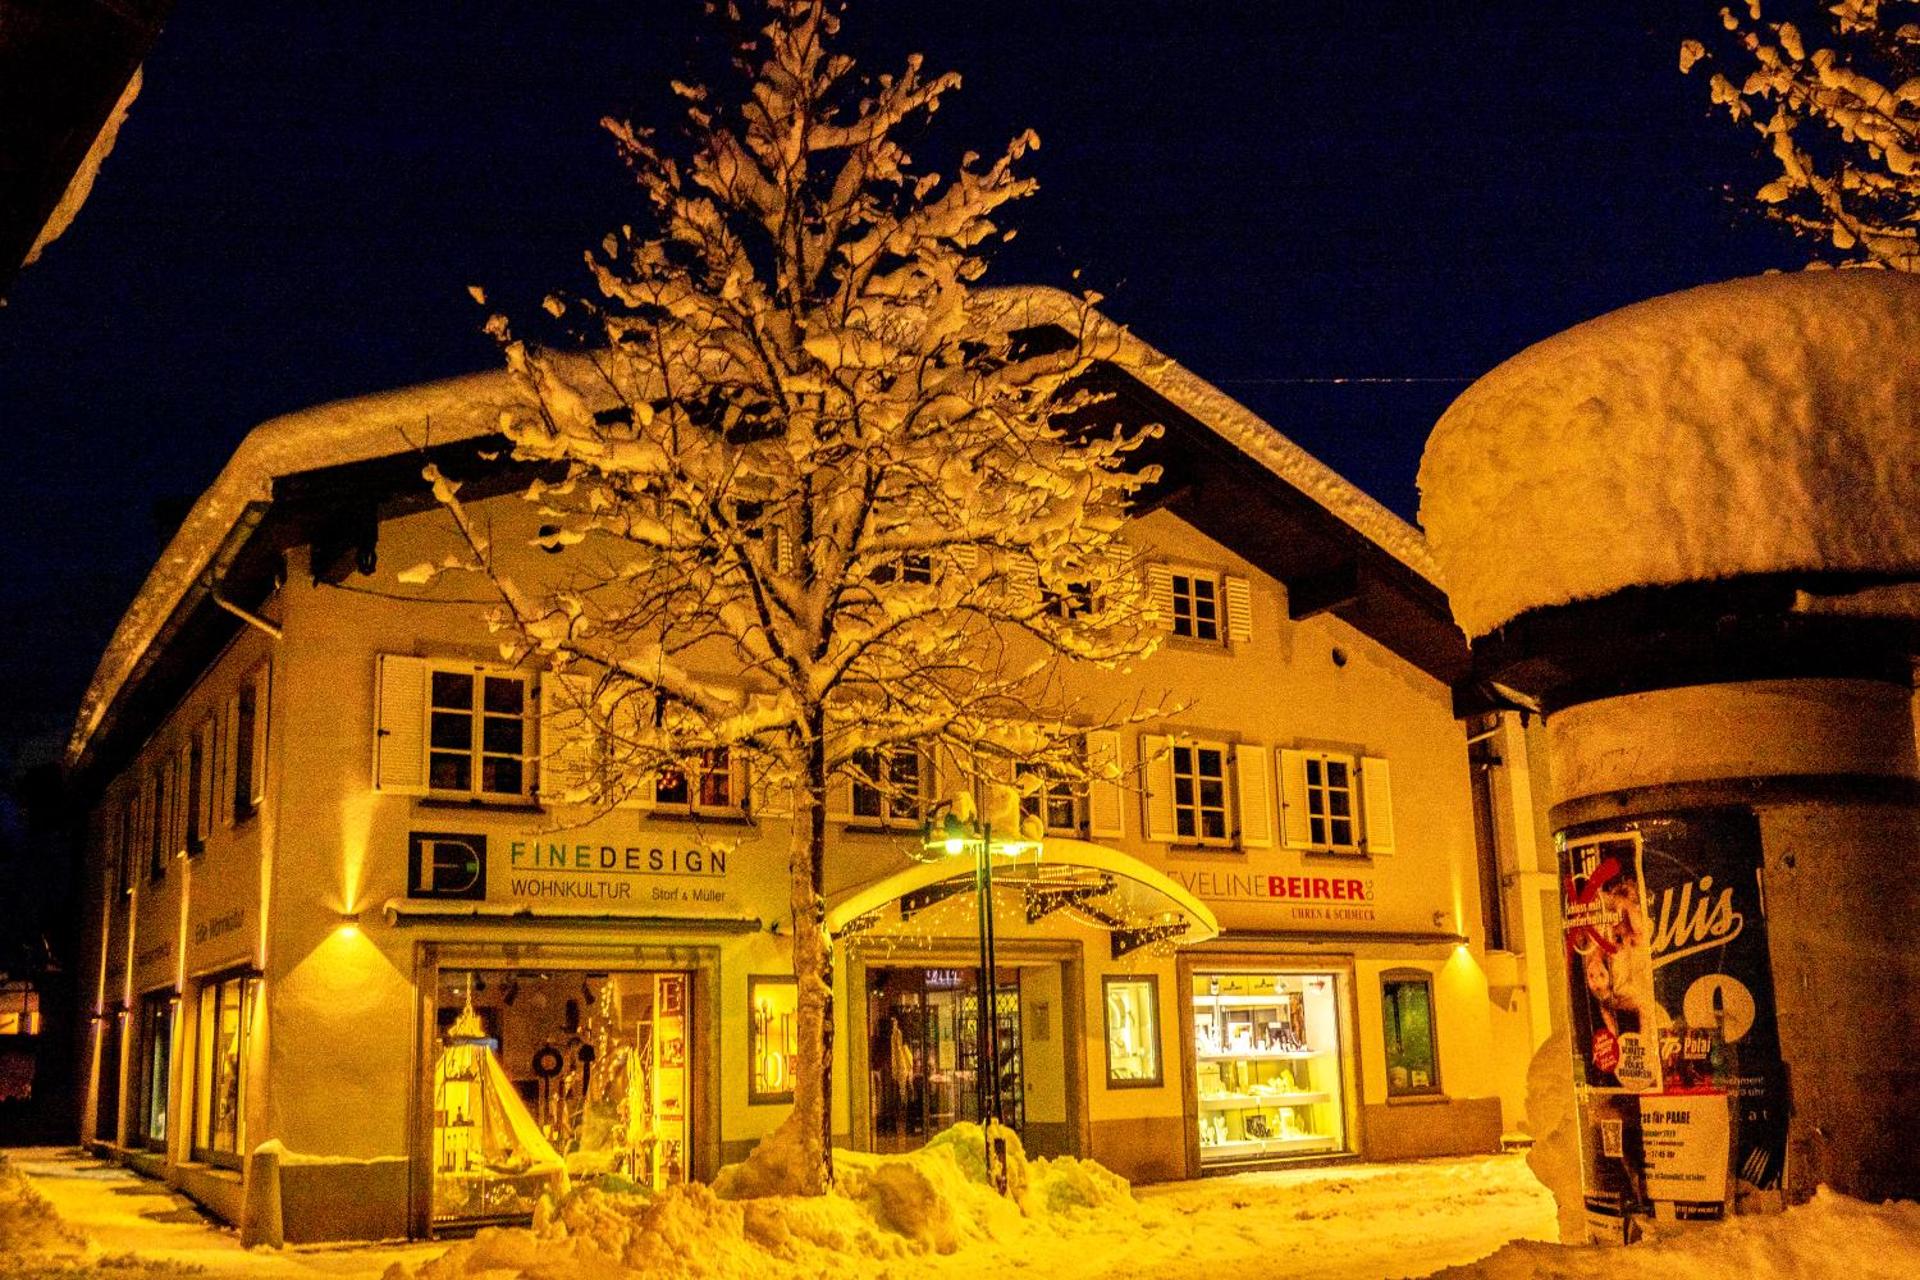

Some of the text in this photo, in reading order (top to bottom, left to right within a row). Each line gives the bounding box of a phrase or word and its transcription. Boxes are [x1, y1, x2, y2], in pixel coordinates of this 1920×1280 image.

[511, 879, 630, 899] WOHNKULTUR
[652, 886, 678, 901] Storf
[693, 889, 726, 902] Müller
[1268, 876, 1365, 901] BEIRER
[1291, 907, 1322, 919] UHREN
[1334, 908, 1376, 921] SCHMUCK
